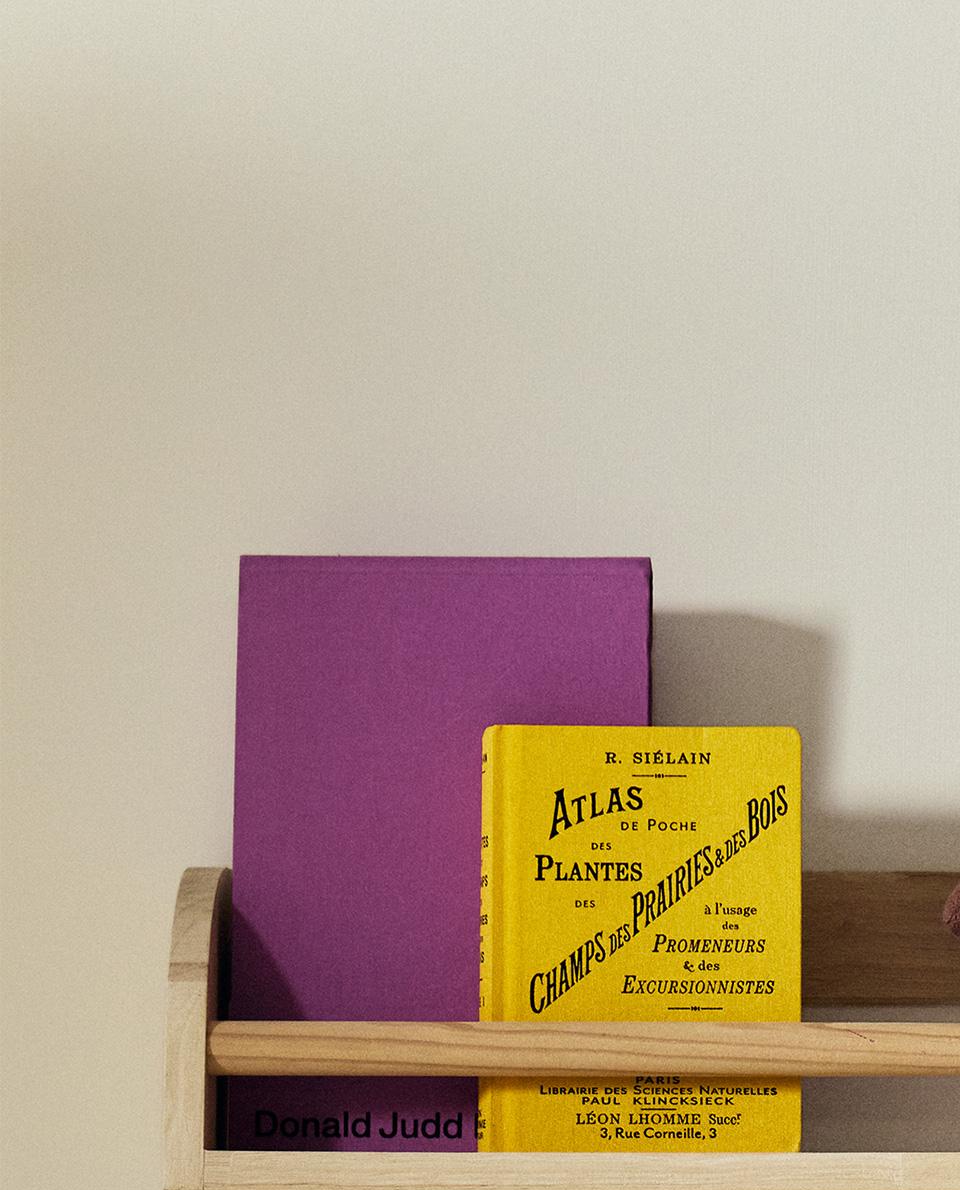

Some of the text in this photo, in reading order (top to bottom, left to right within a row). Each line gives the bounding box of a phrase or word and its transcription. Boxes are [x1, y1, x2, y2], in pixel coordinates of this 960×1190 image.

[605, 749, 712, 764] R. SIÉLAIN
[549, 786, 644, 840] ATLAS
[620, 818, 697, 831] DE POCHE
[591, 841, 611, 851] DES
[535, 854, 643, 881] PLANTES
[529, 931, 606, 1014] CHAMPS
[609, 923, 632, 957] DES
[631, 845, 714, 937] PRAIRIES
[724, 829, 747, 863] DES
[747, 784, 789, 843] BOIS
[575, 900, 595, 909] DES
[704, 904, 712, 915] à
[722, 921, 739, 930] des
[652, 934, 766, 953] PROMENEURS
[698, 960, 720, 971] des
[621, 975, 775, 994] EXCURSIONNISTES
[635, 1076, 680, 1084] PARIS
[540, 1085, 599, 1095] LIBRAIRIE
[633, 1085, 693, 1095] SCIENCES
[699, 1086, 778, 1095] NATURELLES
[581, 1097, 734, 1105] PAUL KLINCKSIECK
[255, 1110, 371, 1138] Donald
[379, 1111, 462, 1138] Judd
[576, 1111, 620, 1125] LÉON
[629, 1113, 701, 1125] LHOMME
[600, 1128, 717, 1140] 3, Rue Corneille, 3
